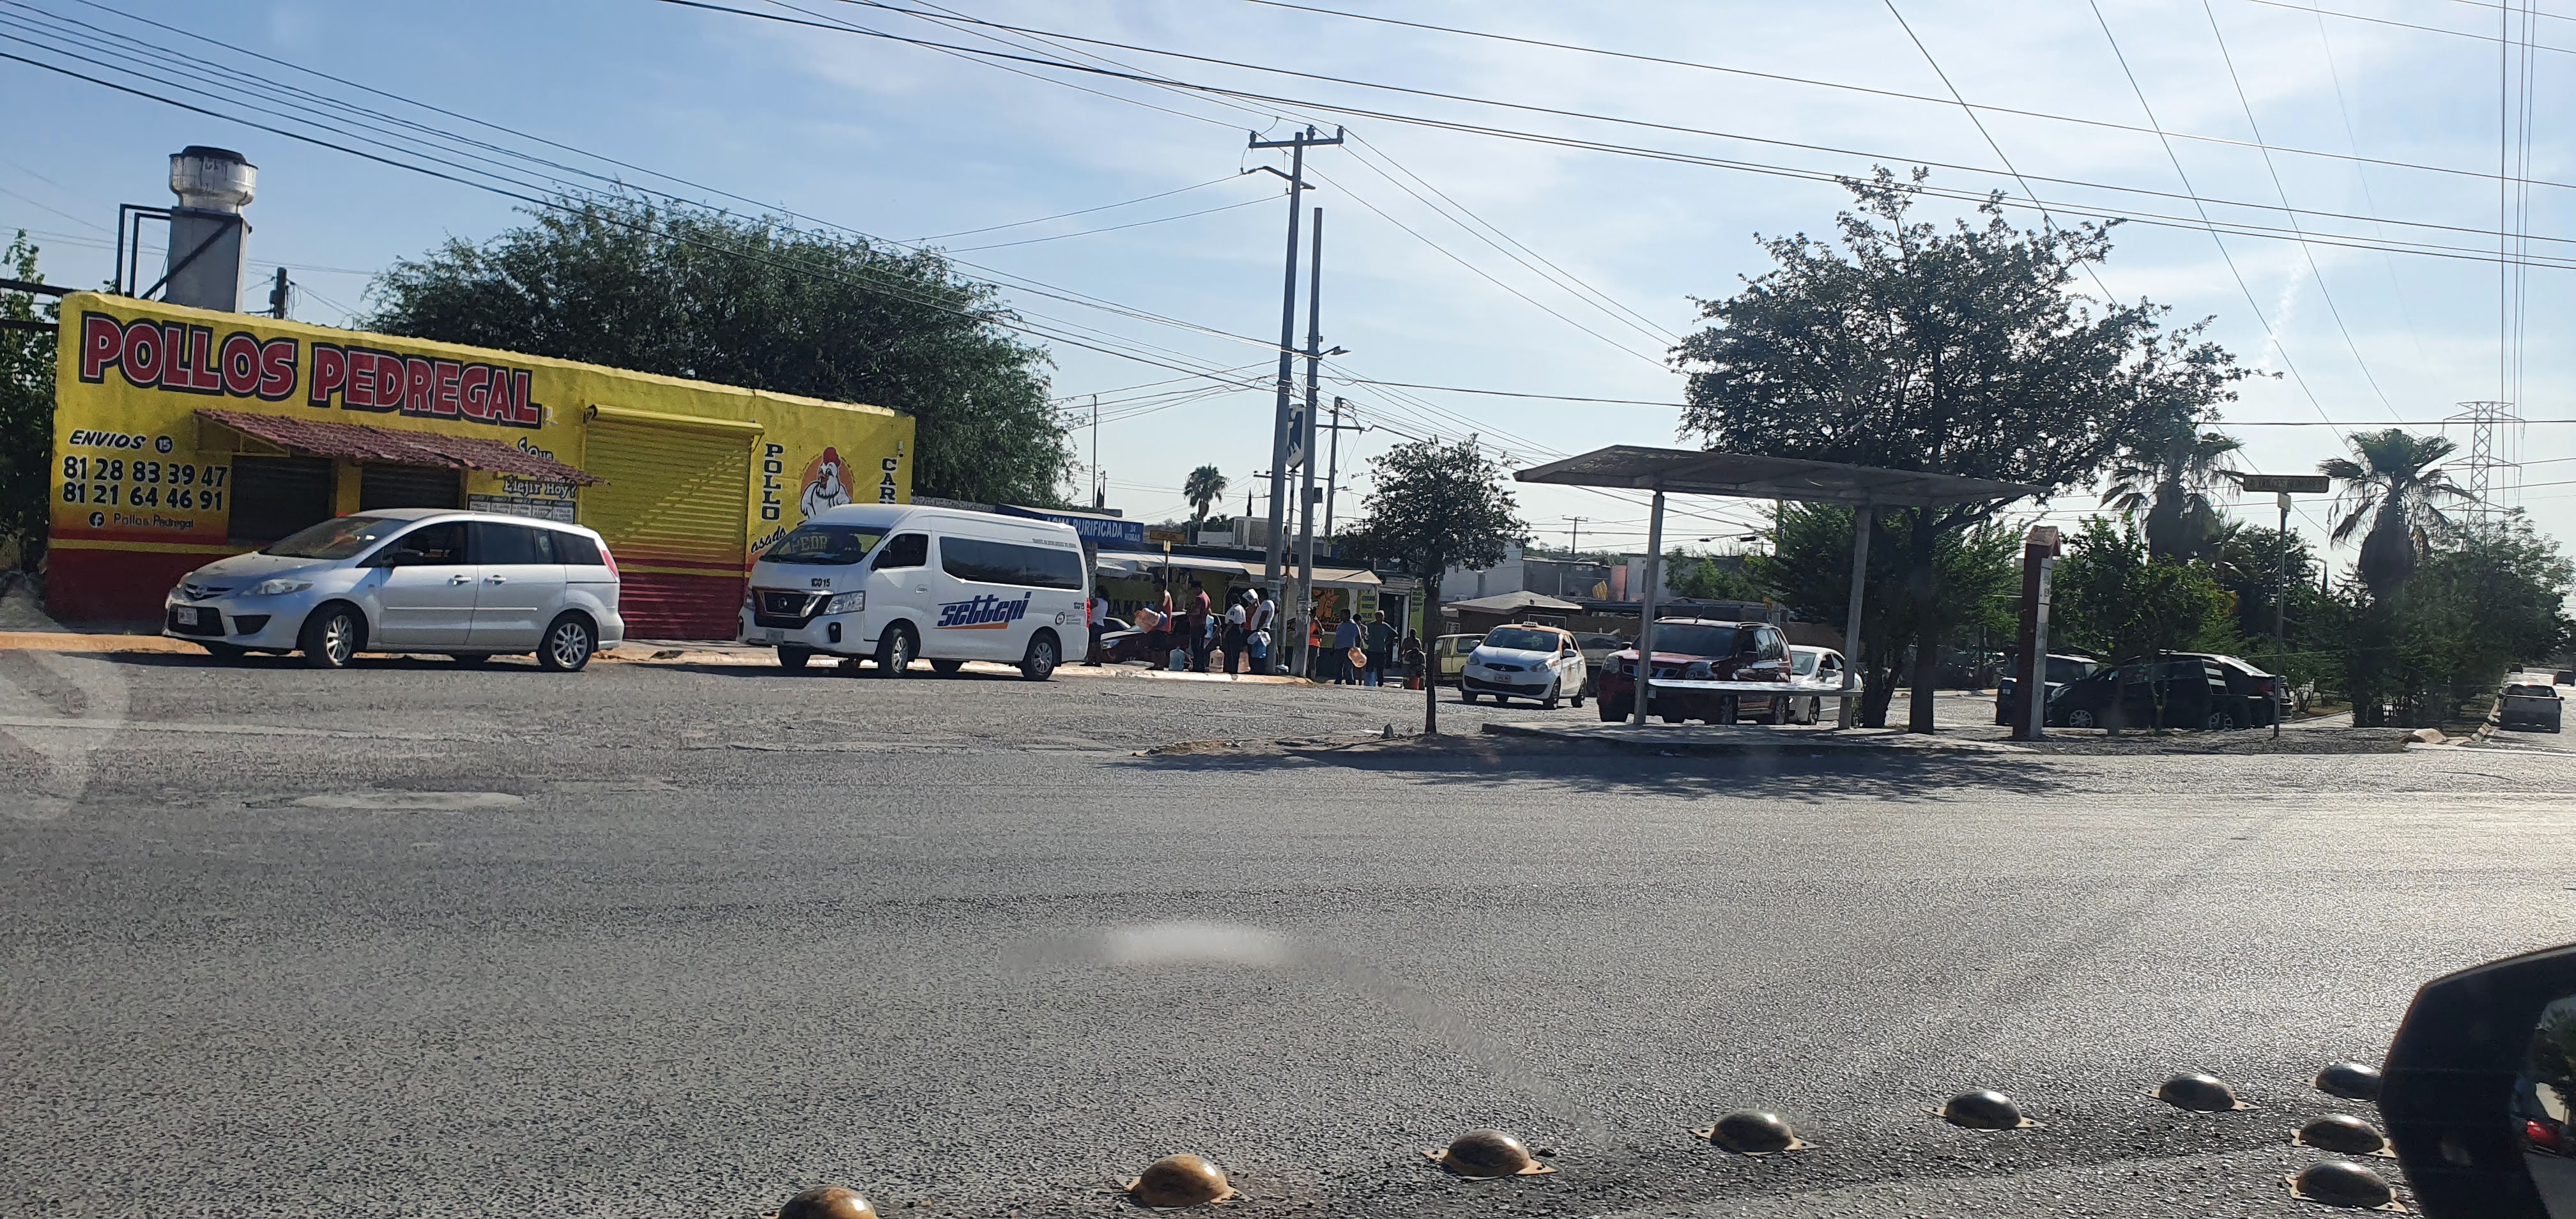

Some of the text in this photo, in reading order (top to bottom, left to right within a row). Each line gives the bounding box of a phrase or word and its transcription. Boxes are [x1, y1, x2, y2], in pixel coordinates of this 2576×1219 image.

[80, 312, 541, 428] POLLOS PEDREGAL
[69, 429, 147, 449] ENVIOS
[63, 456, 227, 487] 81 28 83 39 47
[761, 443, 783, 521] POLLO
[878, 458, 897, 503] CAR
[63, 482, 222, 510] 81 21 64 46 91
[113, 513, 150, 526] Pollos
[153, 514, 194, 531] Pedregal
[1073, 519, 1123, 538] PURIFICADA
[751, 526, 786, 554] asado
